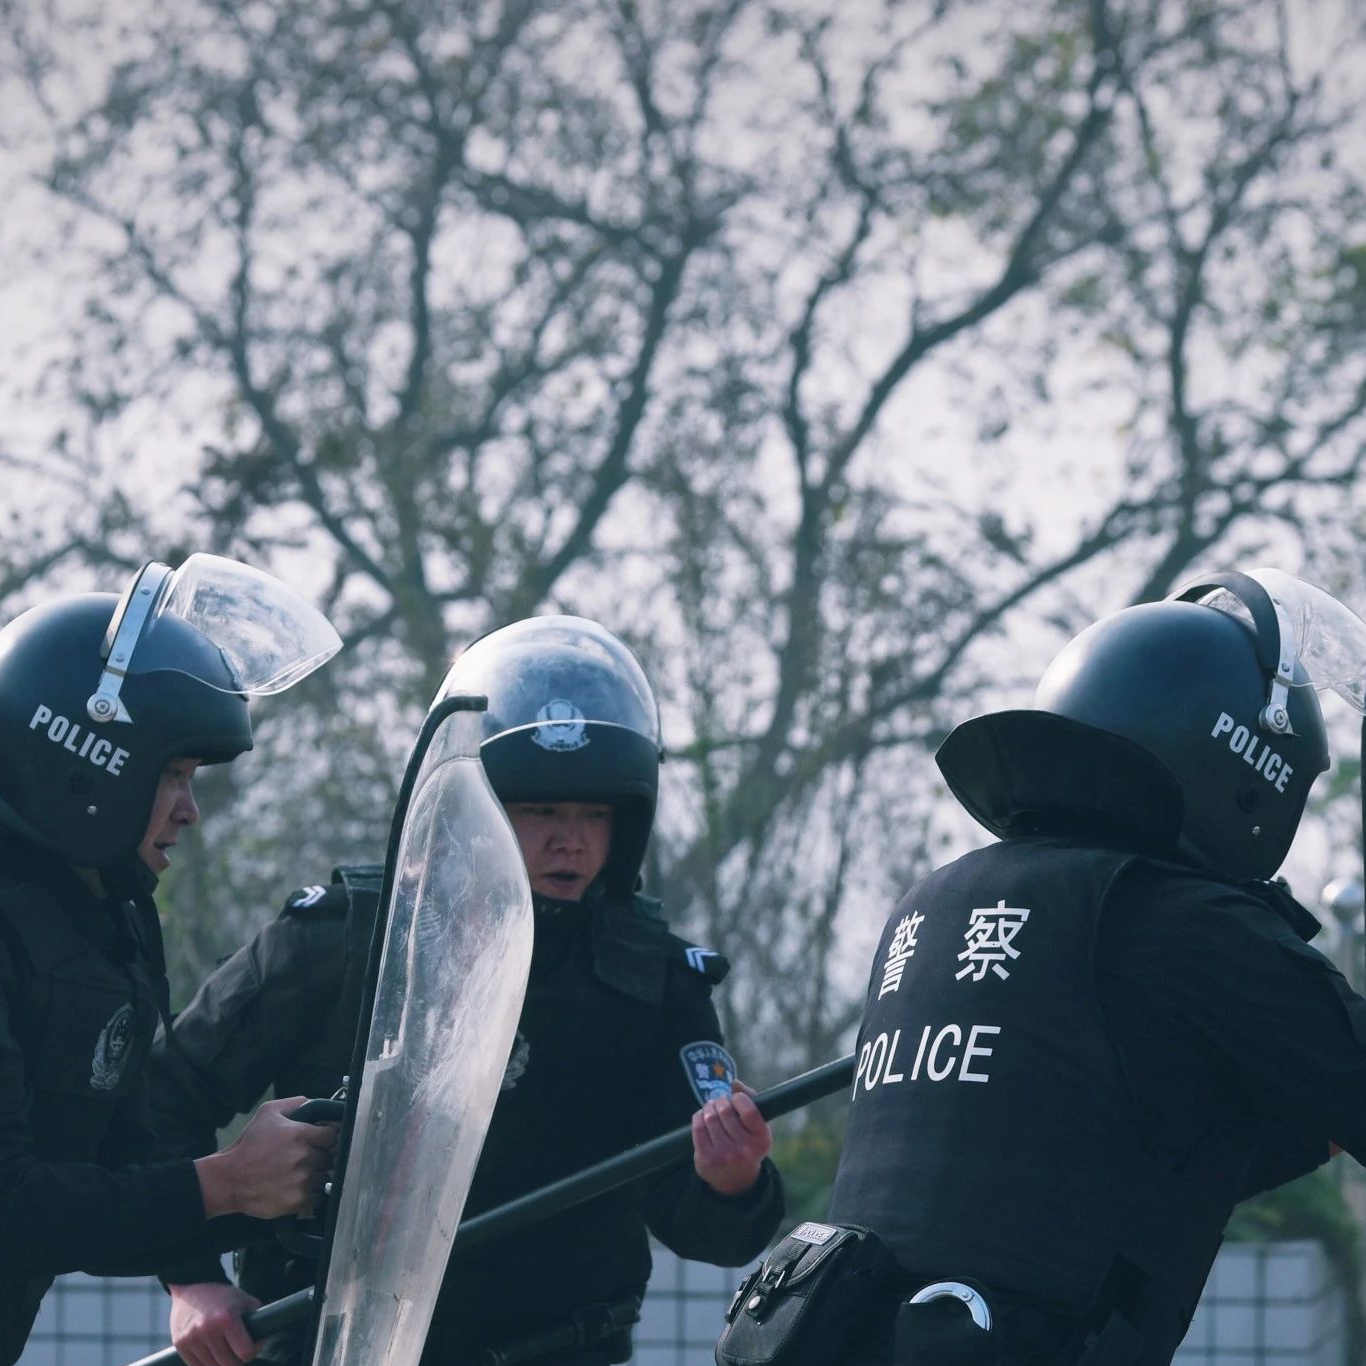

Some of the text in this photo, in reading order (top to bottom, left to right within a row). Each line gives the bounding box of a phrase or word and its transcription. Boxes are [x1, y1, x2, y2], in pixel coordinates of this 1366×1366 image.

[29, 704, 131, 777] POLICE
[1211, 712, 1294, 794] POLICE
[878, 899, 1031, 1001] 警察
[852, 1023, 1002, 1102] POLICE
